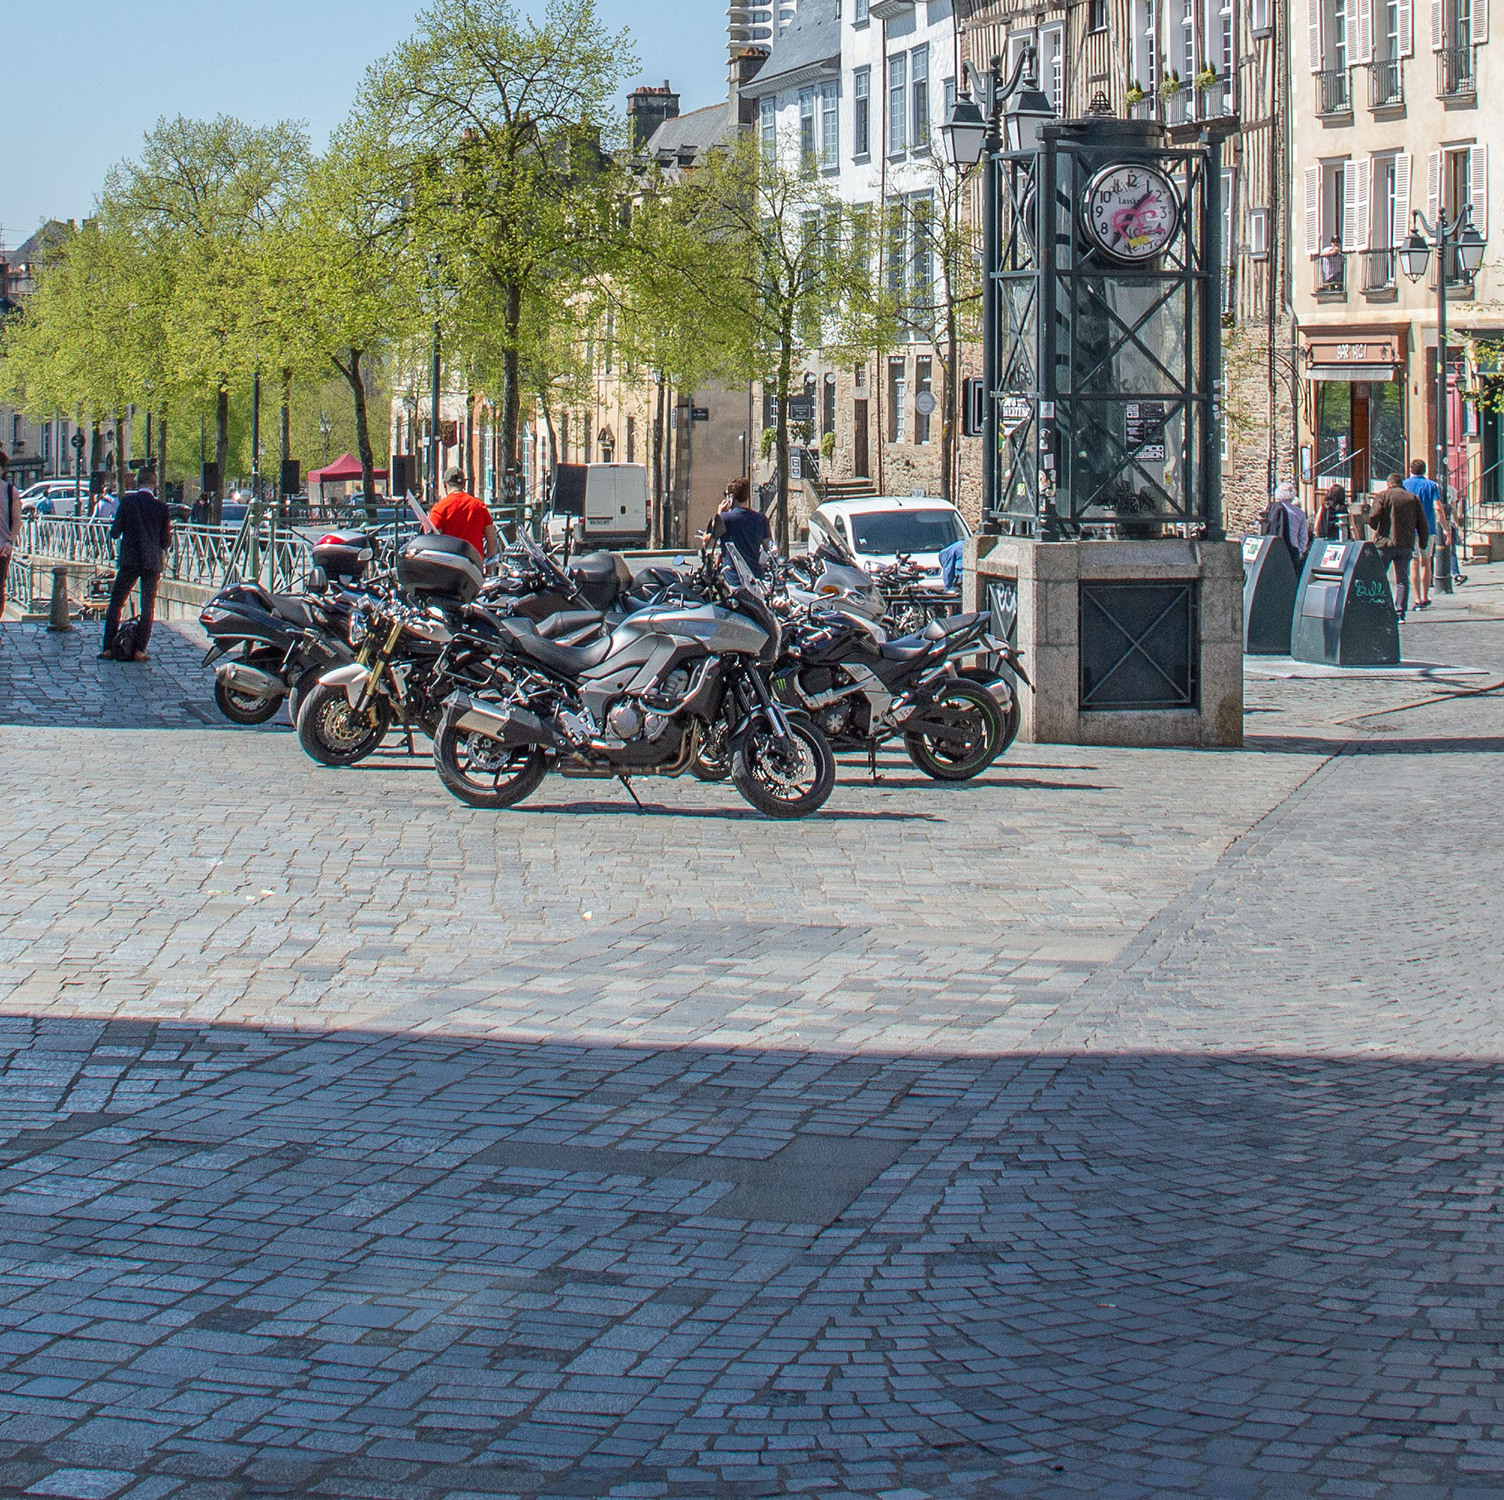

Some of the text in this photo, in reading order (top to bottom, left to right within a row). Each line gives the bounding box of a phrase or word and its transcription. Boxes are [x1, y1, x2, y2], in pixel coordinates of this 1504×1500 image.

[1127, 174, 1137, 188] 12
[1100, 191, 1112, 204] 10
[1156, 190, 1163, 203] 2
[1095, 205, 1104, 218] 9
[1160, 206, 1167, 219] 3
[1100, 222, 1109, 235] 8
